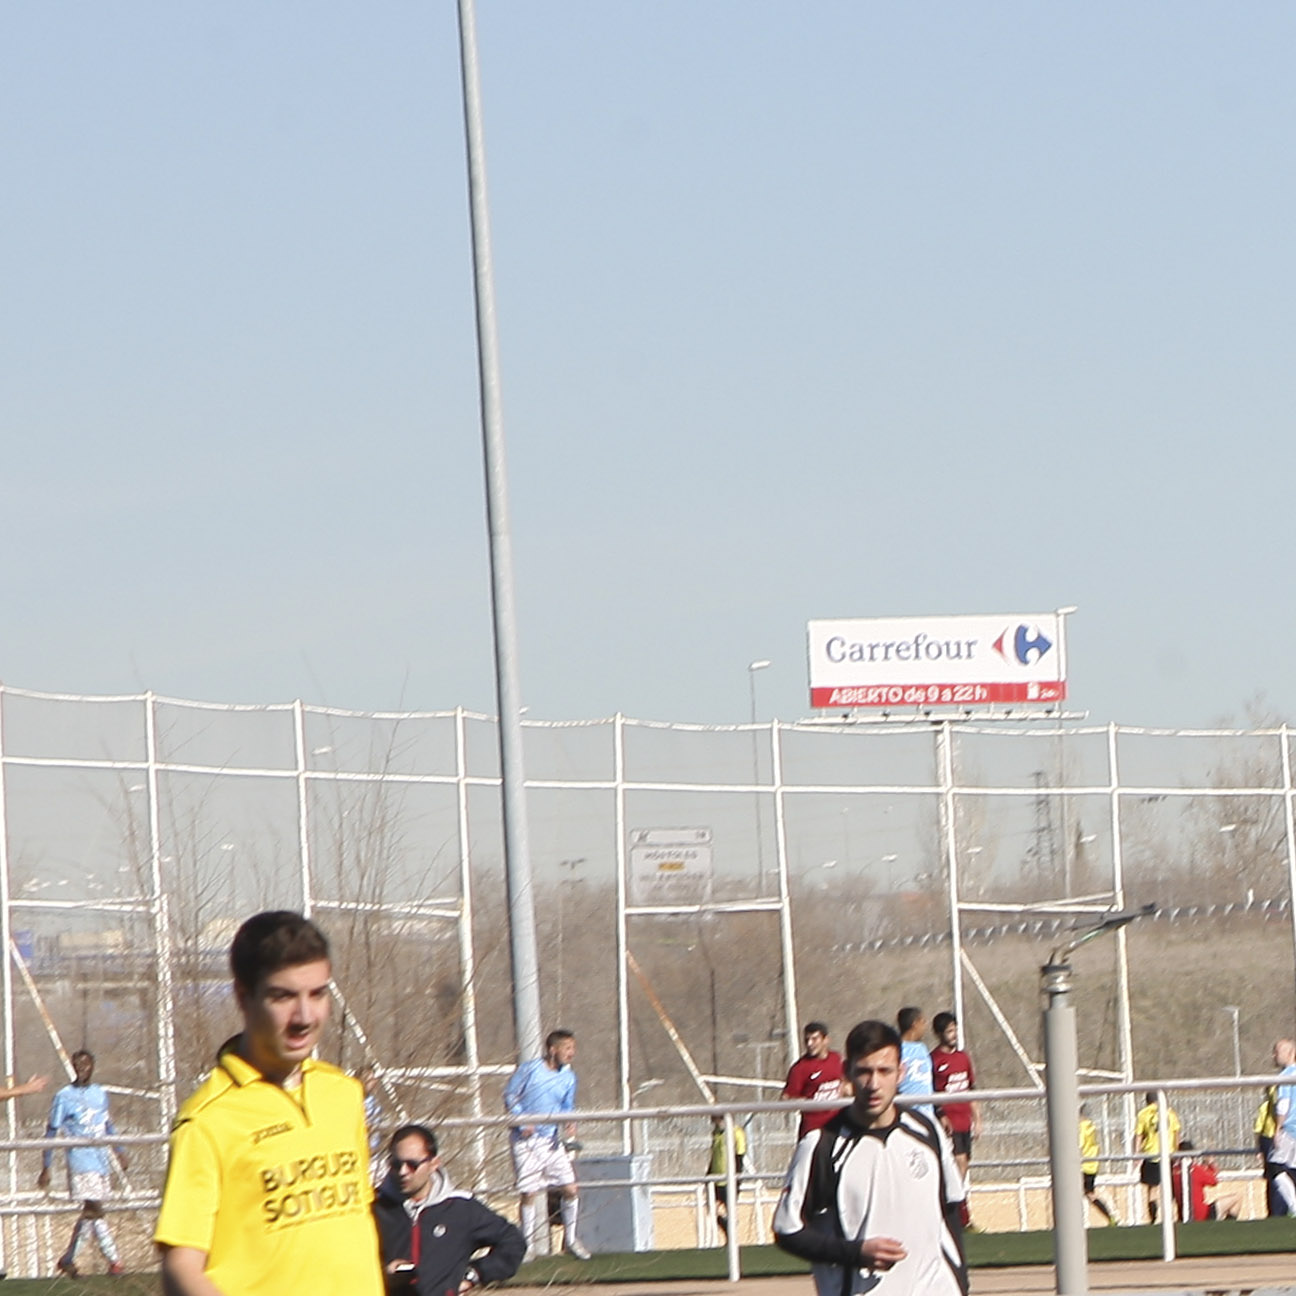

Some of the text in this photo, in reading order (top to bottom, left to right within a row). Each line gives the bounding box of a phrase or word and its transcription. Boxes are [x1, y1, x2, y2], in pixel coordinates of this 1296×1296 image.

[825, 633, 978, 663] Carrefour
[829, 686, 903, 704] ABIERTO
[927, 685, 940, 702] 9
[952, 685, 975, 702] 22
